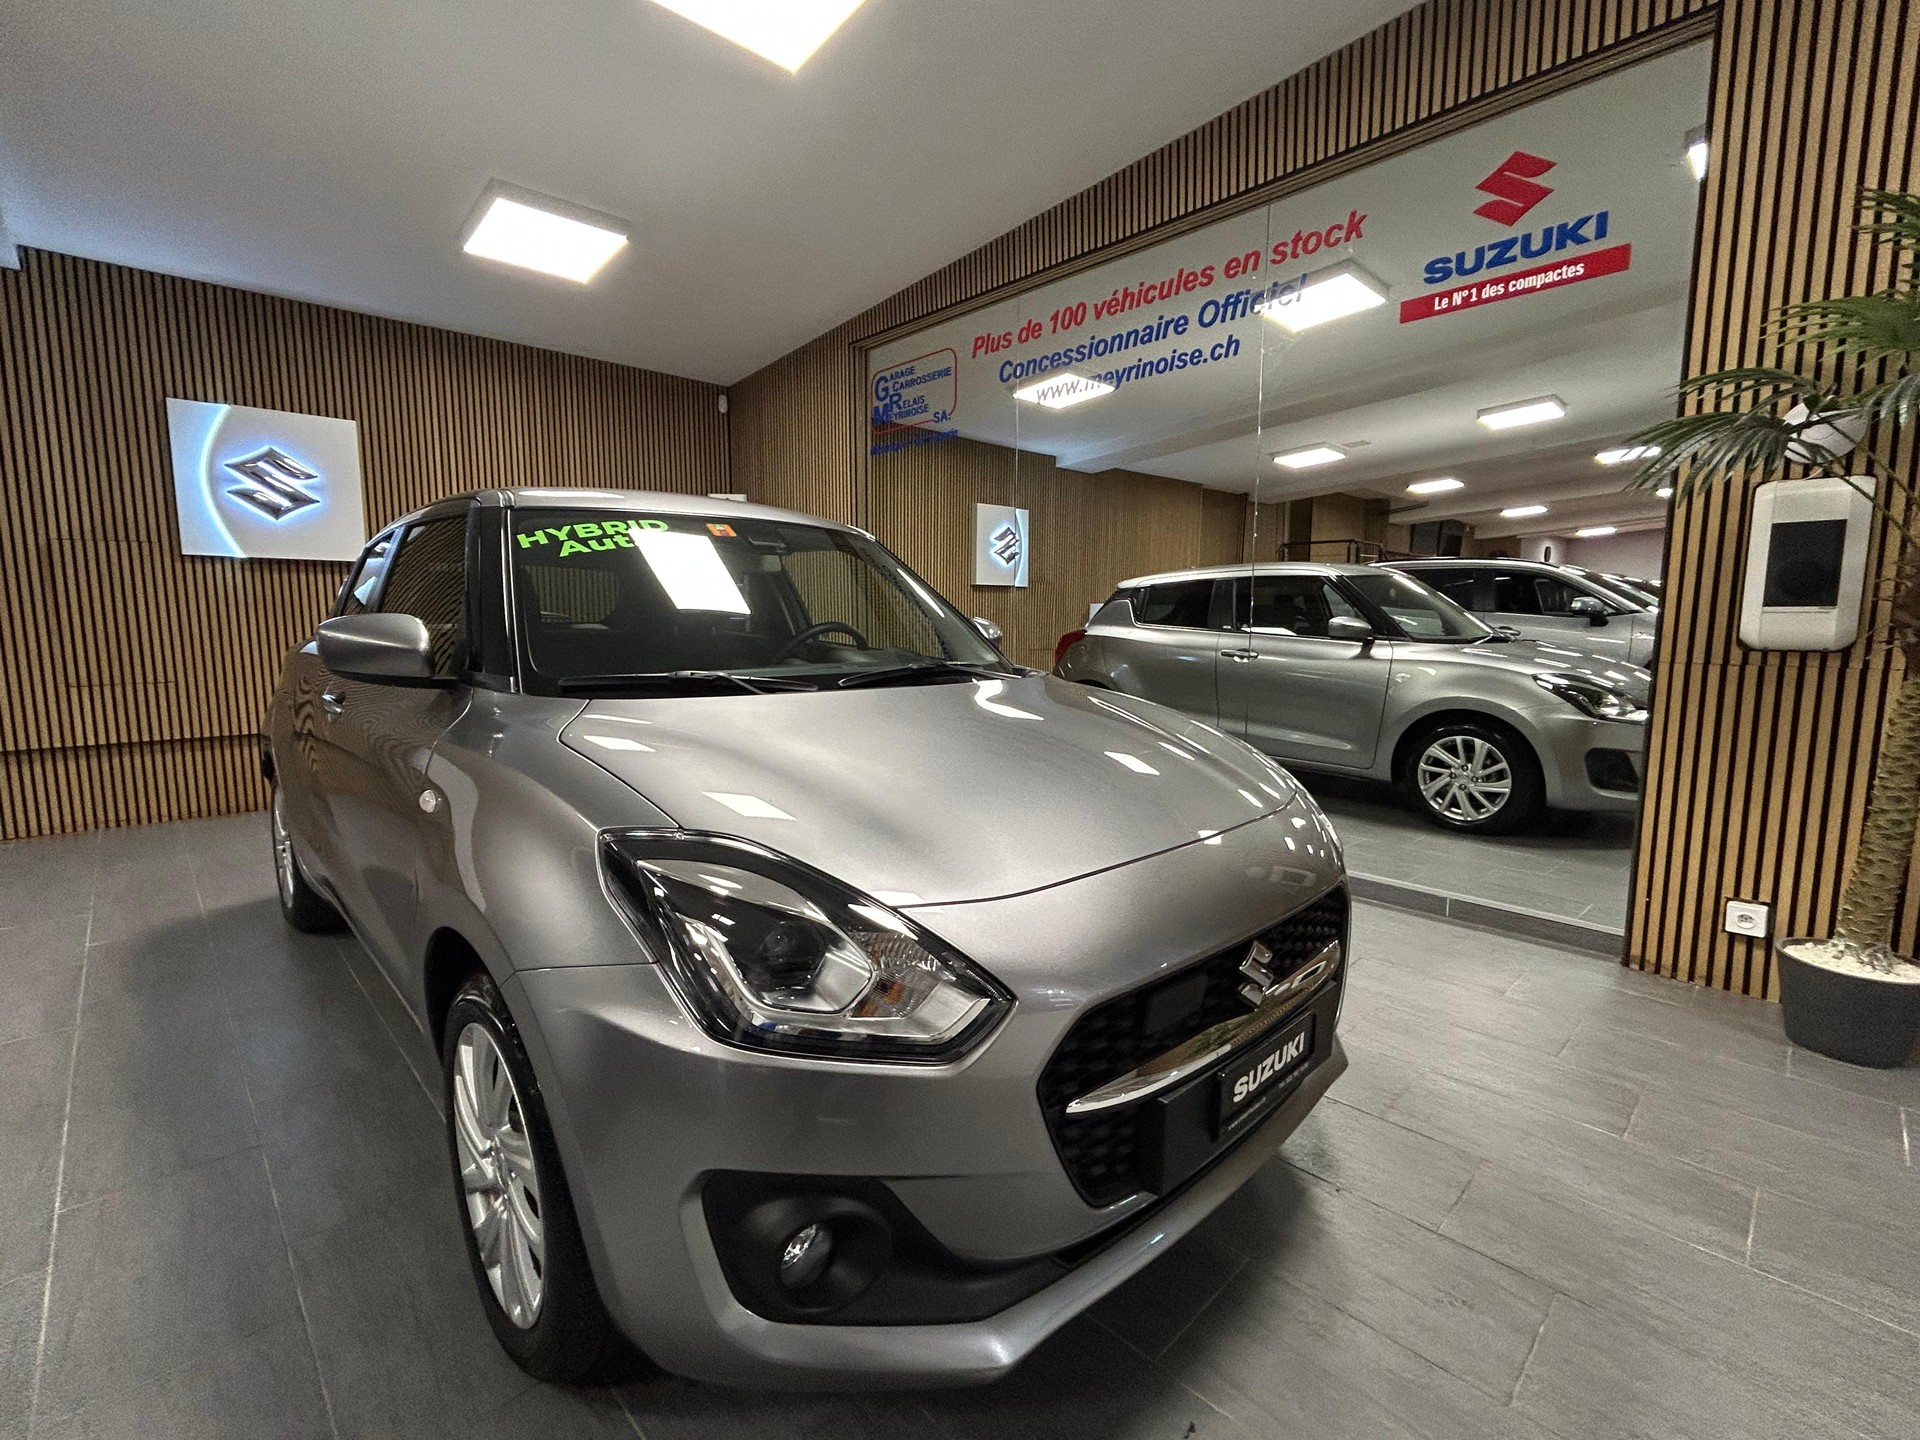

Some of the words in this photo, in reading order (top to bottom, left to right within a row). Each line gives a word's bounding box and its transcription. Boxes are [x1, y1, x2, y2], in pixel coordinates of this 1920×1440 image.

[1423, 210, 1609, 284] SUZUKI
[972, 332, 1013, 359] Plus
[1017, 319, 1043, 344] de
[1050, 302, 1087, 333] 100
[1093, 264, 1216, 320] véhicules
[1224, 250, 1261, 279] en
[1270, 209, 1368, 264] stock
[1434, 296, 1449, 311] Le
[1481, 282, 1505, 299] des
[1508, 263, 1585, 292] compactes
[999, 314, 1189, 384] Concessionnaire
[1198, 273, 1309, 328] Officiel
[875, 366, 916, 402] GARAGE
[892, 366, 952, 392] CARROSSERIE
[1036, 334, 1241, 402] www.meyrinoise.ch
[889, 392, 925, 413] RELAIS
[516, 519, 669, 549] HYBRID
[559, 534, 638, 557] Aut
[1233, 1031, 1305, 1103] SUZUKI
